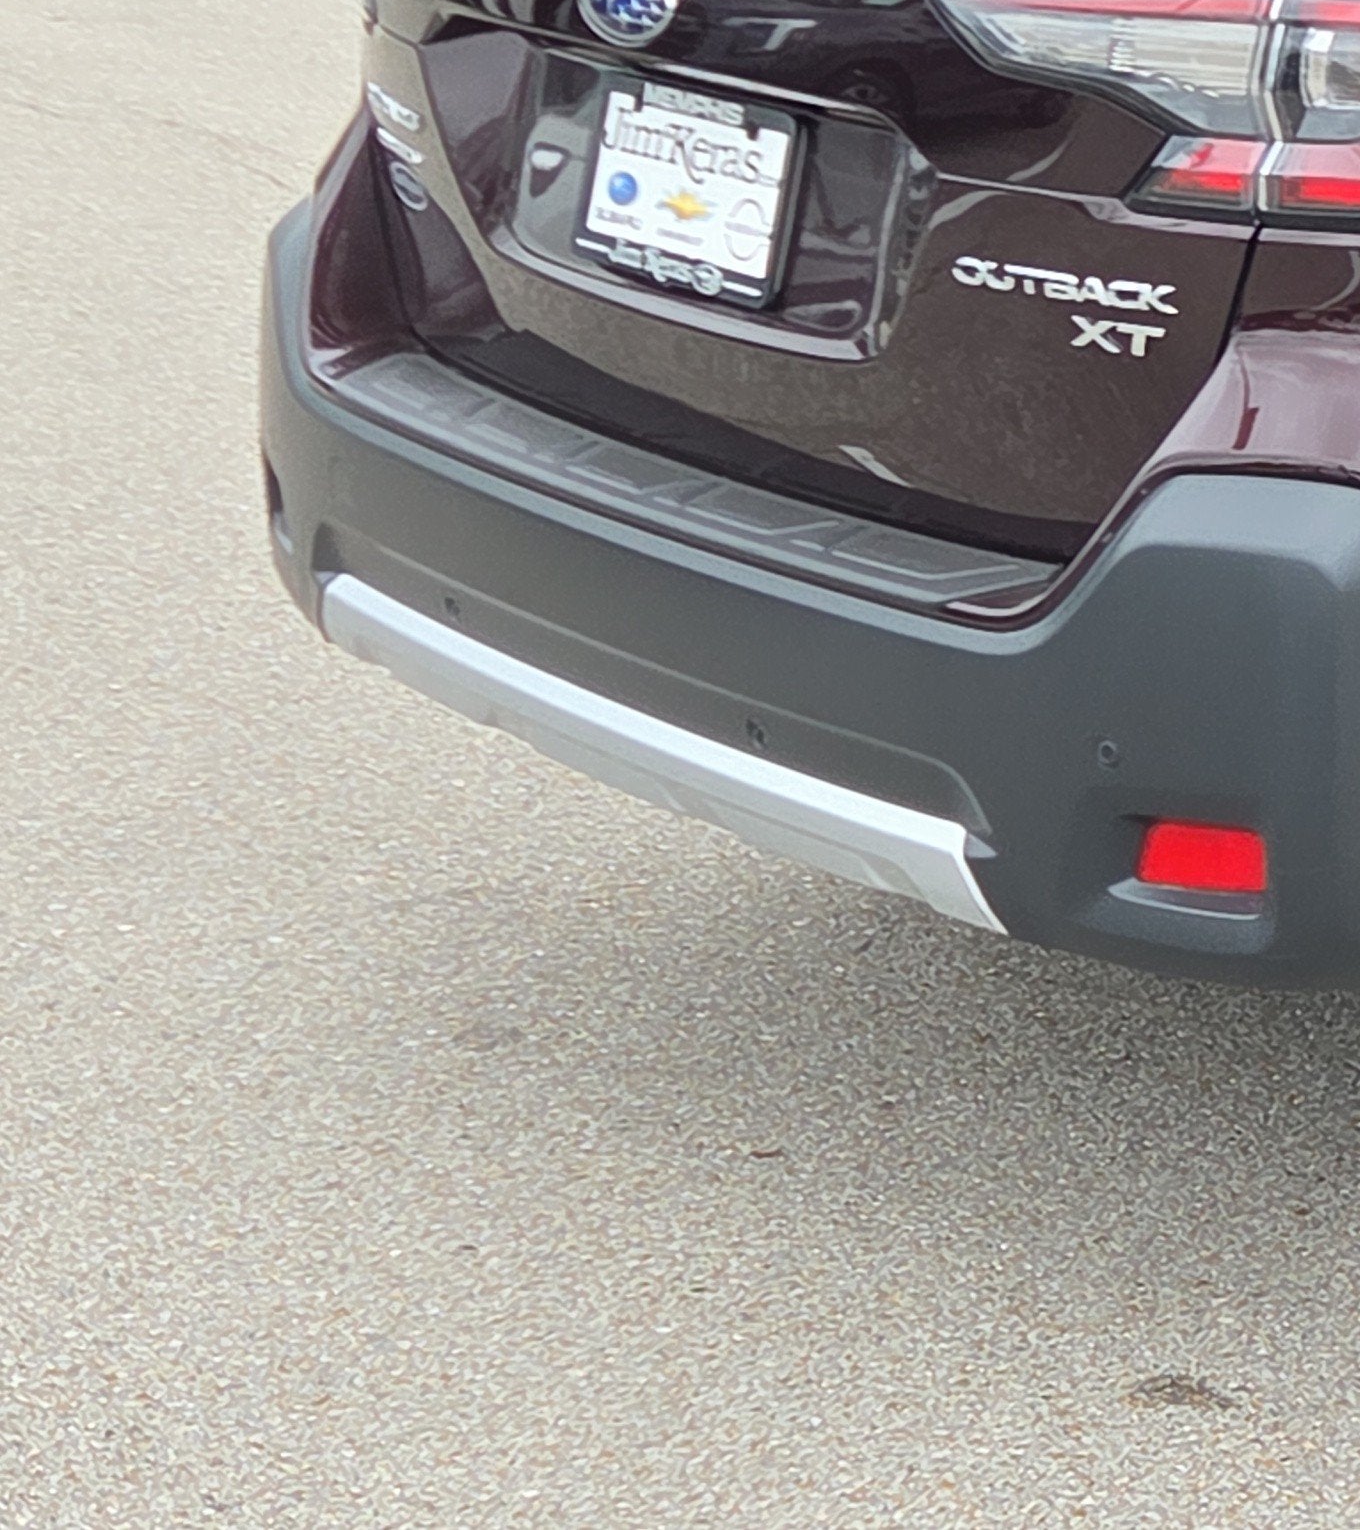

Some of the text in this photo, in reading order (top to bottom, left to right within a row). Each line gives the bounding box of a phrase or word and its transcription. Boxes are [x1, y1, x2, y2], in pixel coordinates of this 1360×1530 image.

[643, 82, 745, 126] MEMPHIS
[951, 256, 1180, 315] OUTBACK
[1070, 315, 1166, 357] XT
